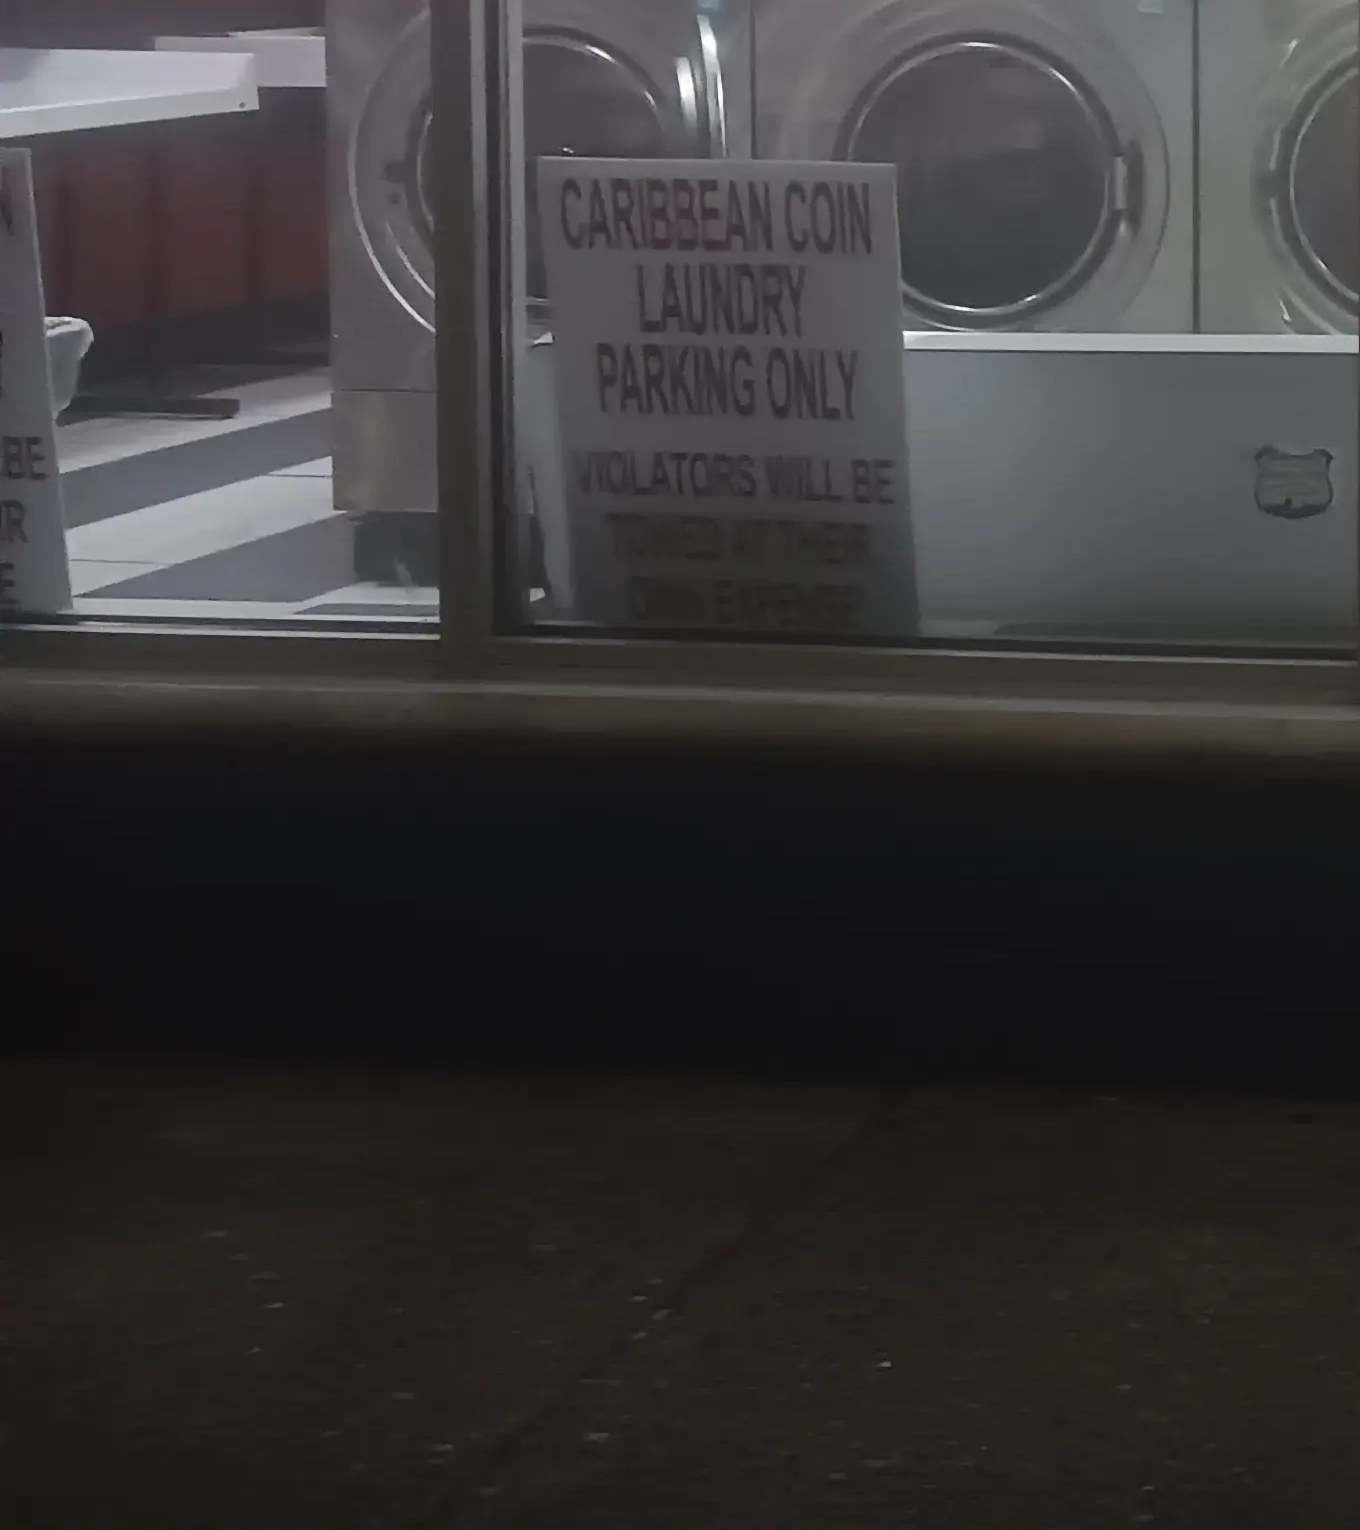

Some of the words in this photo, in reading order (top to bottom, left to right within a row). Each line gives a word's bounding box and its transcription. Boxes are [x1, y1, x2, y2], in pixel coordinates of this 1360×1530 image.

[560, 178, 772, 253] CARIBBEAN
[784, 181, 873, 254] COIN
[637, 264, 808, 337] LAUNDRY
[597, 344, 757, 419] PARKING
[766, 349, 859, 421] ONLY
[3, 436, 47, 480] BE
[576, 449, 756, 497] VIOLATORS
[763, 455, 844, 502] WILL
[853, 458, 895, 504] BE
